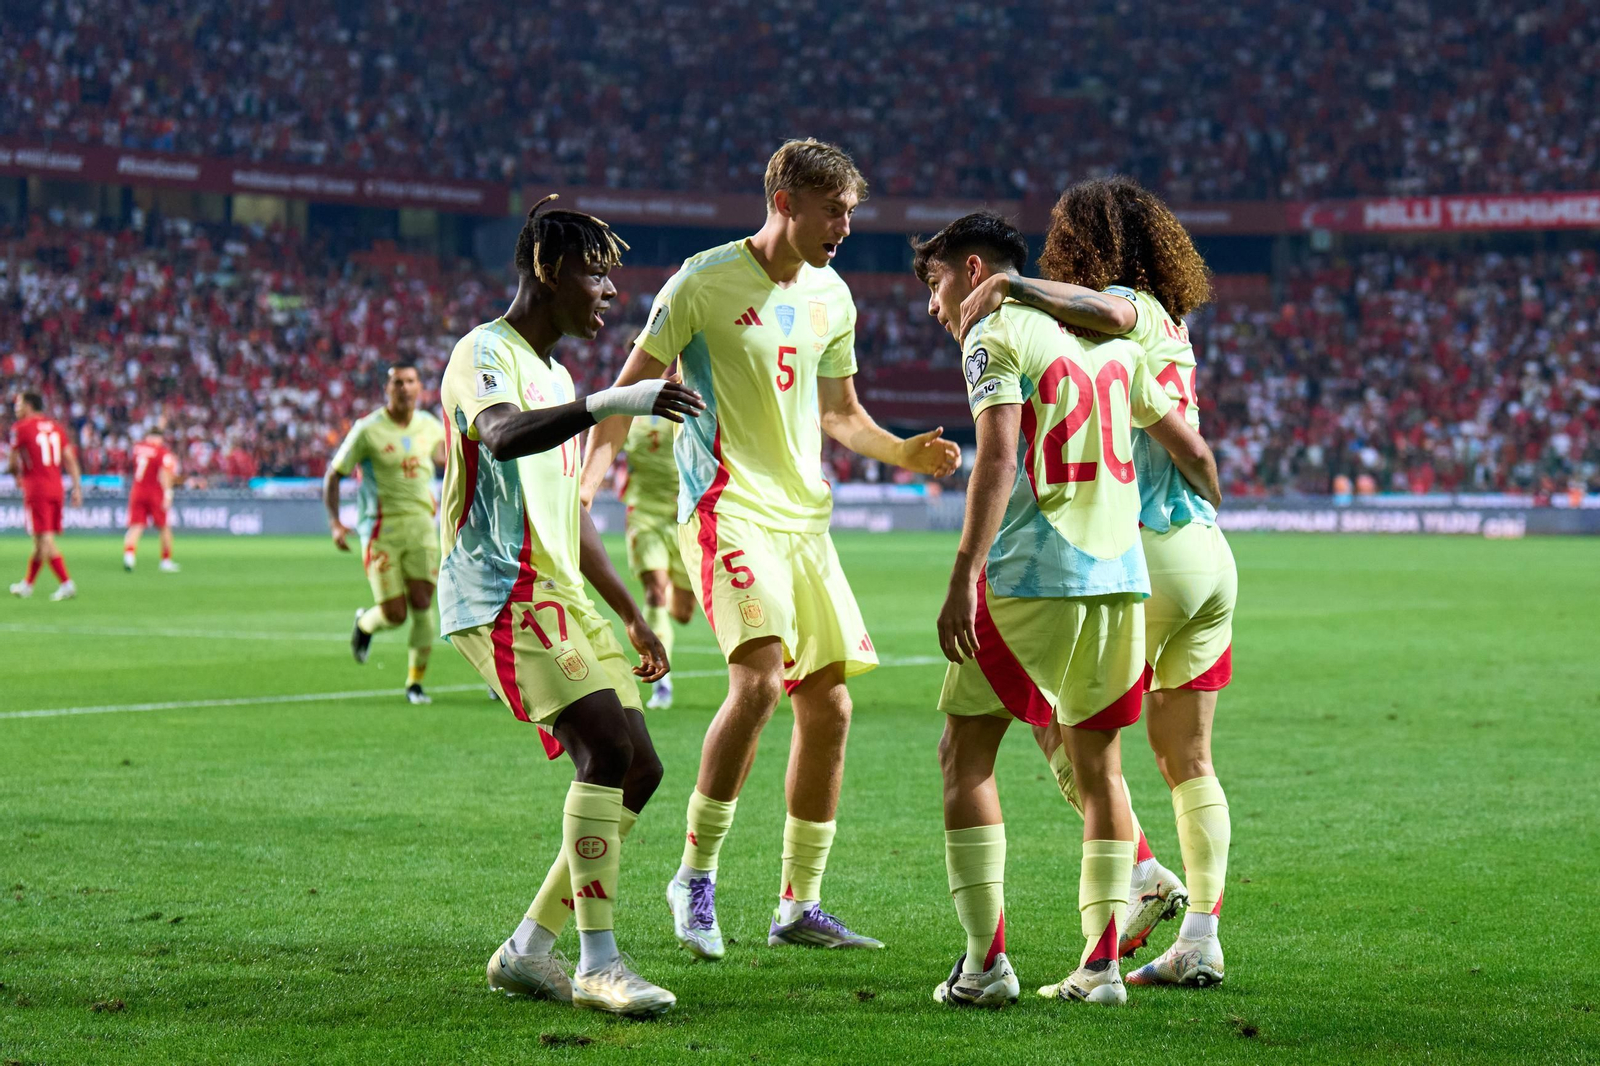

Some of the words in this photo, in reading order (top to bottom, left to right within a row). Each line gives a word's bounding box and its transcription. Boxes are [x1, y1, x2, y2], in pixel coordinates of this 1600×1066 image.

[776, 346, 796, 392] 5
[1038, 355, 1136, 484] 20
[36, 432, 61, 467] 11
[721, 549, 755, 589] 5
[520, 601, 568, 650] 17
